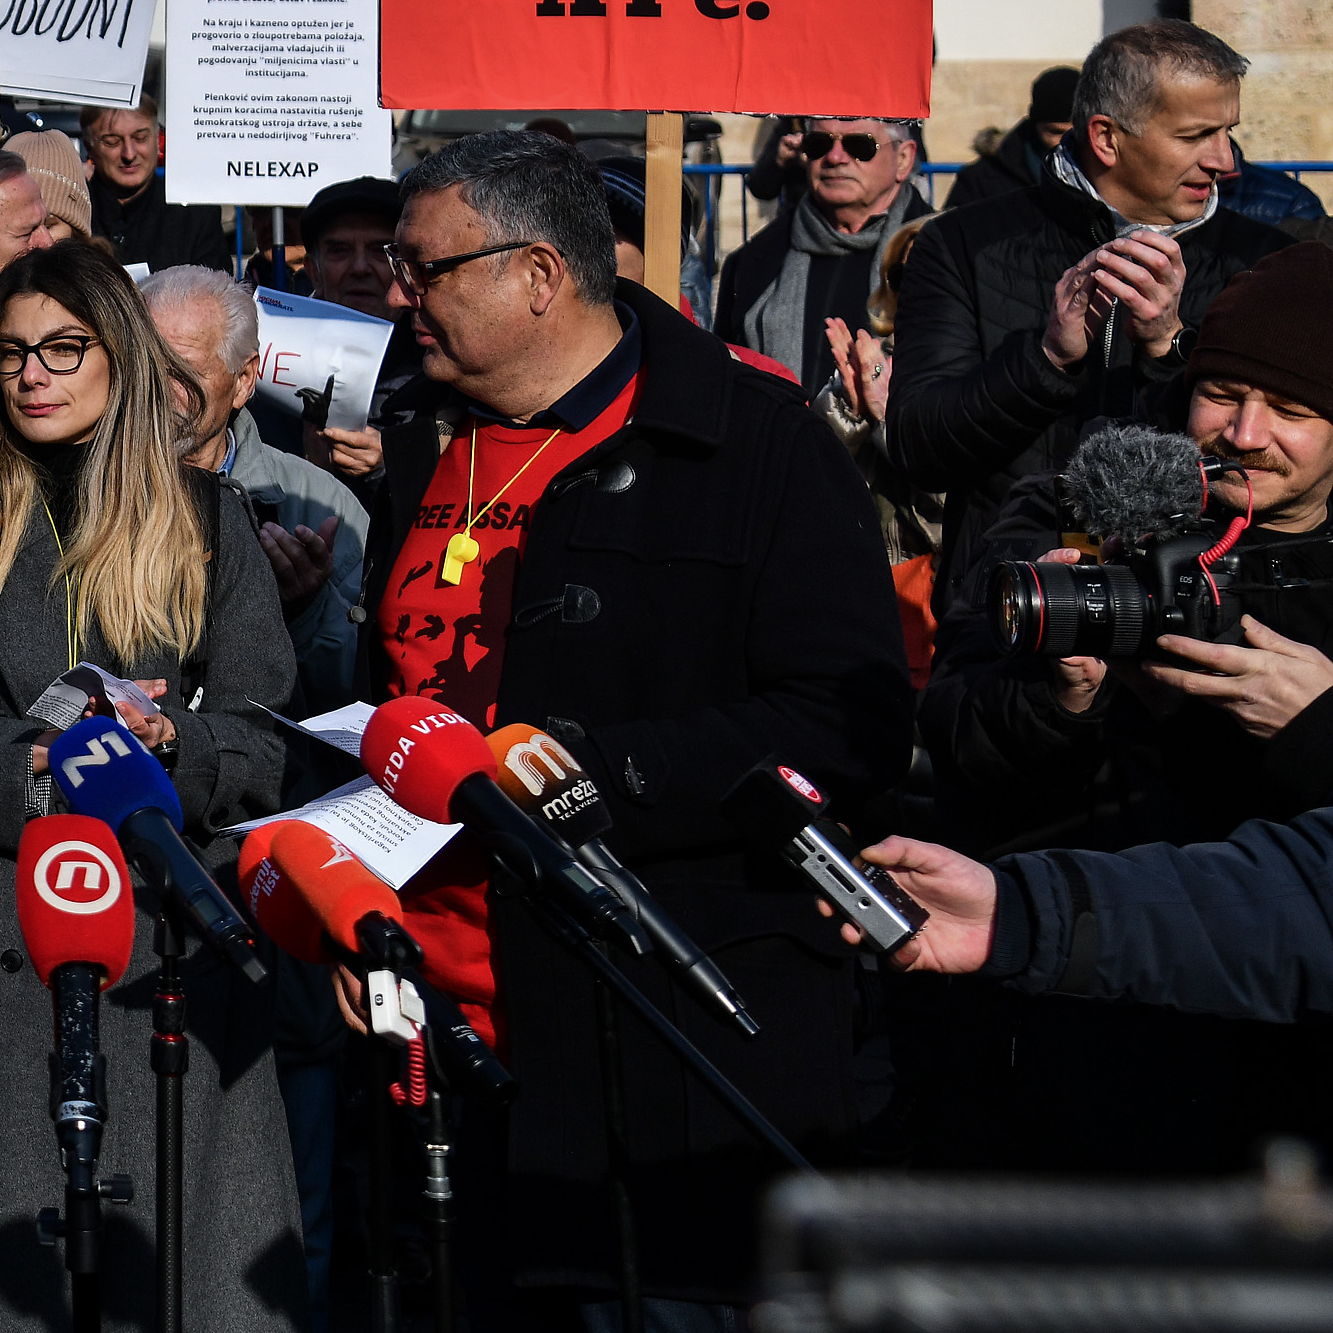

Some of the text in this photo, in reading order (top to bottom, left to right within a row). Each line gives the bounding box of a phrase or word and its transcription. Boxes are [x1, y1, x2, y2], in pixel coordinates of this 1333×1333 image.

[218, 18, 242, 28] kraju
[250, 19, 289, 27] kazneno
[291, 20, 329, 29] optužen
[330, 20, 343, 30] jer
[345, 21, 354, 30] je
[192, 31, 241, 41] progovorio
[252, 31, 322, 41] zloupotrebama
[324, 32, 365, 42] položaja,
[212, 43, 284, 54] malverzacijama
[287, 44, 334, 54] vladajućih
[198, 56, 257, 66] pogodovanju
[245, 69, 308, 79] institucijama.
[205, 93, 248, 101] Plenković
[276, 94, 318, 102] zakonom
[320, 95, 352, 105] nastoji
[193, 105, 232, 115] krupnim
[235, 106, 278, 114] koracima
[329, 107, 363, 117] rušenje
[194, 118, 260, 128] demokratskog
[262, 119, 295, 129] ustroja
[297, 119, 330, 128] države,
[341, 120, 362, 128] sebe
[197, 132, 236, 140] pretvara
[247, 131, 308, 141] nedodirljivog
[227, 161, 319, 178] NELEXAP
[1179, 576, 1193, 584] EOS
[61, 730, 133, 788] N1
[382, 736, 417, 794] VIDA
[542, 779, 599, 820] mreža
[261, 870, 281, 897] list
